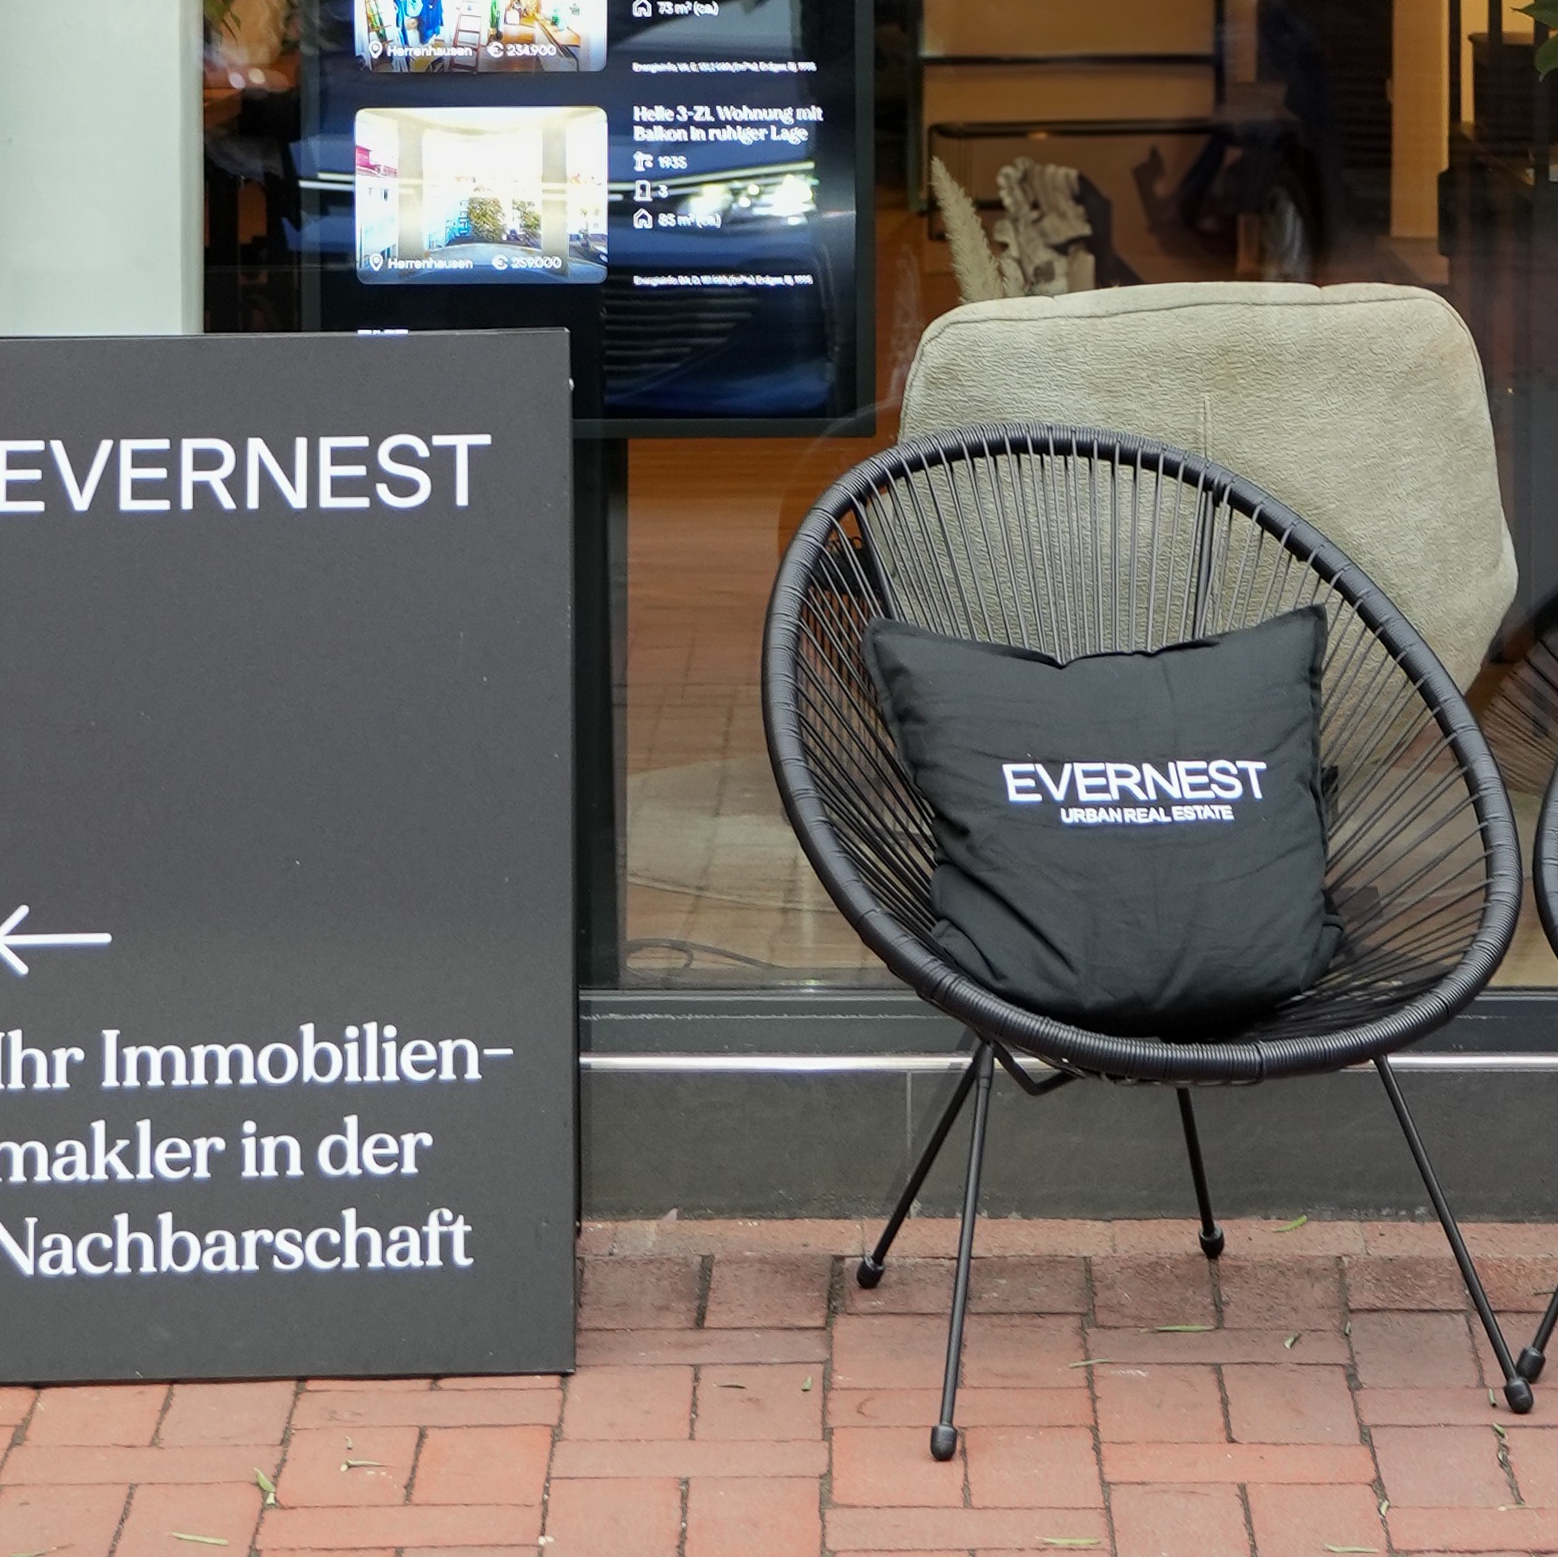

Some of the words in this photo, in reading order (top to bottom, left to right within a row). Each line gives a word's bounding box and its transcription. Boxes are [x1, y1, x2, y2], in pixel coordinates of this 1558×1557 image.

[386, 44, 473, 57] Herrenhausen
[633, 105, 675, 122] Helle
[716, 105, 795, 125] Wohnung
[795, 105, 824, 121] mit
[633, 125, 689, 142] Balkon
[689, 125, 707, 141] in
[708, 125, 770, 145] ruhiger
[770, 125, 809, 145] Lage
[657, 184, 669, 198] 3
[387, 257, 474, 270] Herrenhausen
[1001, 759, 1268, 802] EVERNEST
[1060, 807, 1124, 824] URBAN
[1123, 807, 1172, 823] REAL
[1171, 804, 1235, 821] ESTATE
[100, 1020, 515, 1090] Immobilien-
[240, 1119, 305, 1180] in
[317, 1114, 434, 1178] der
